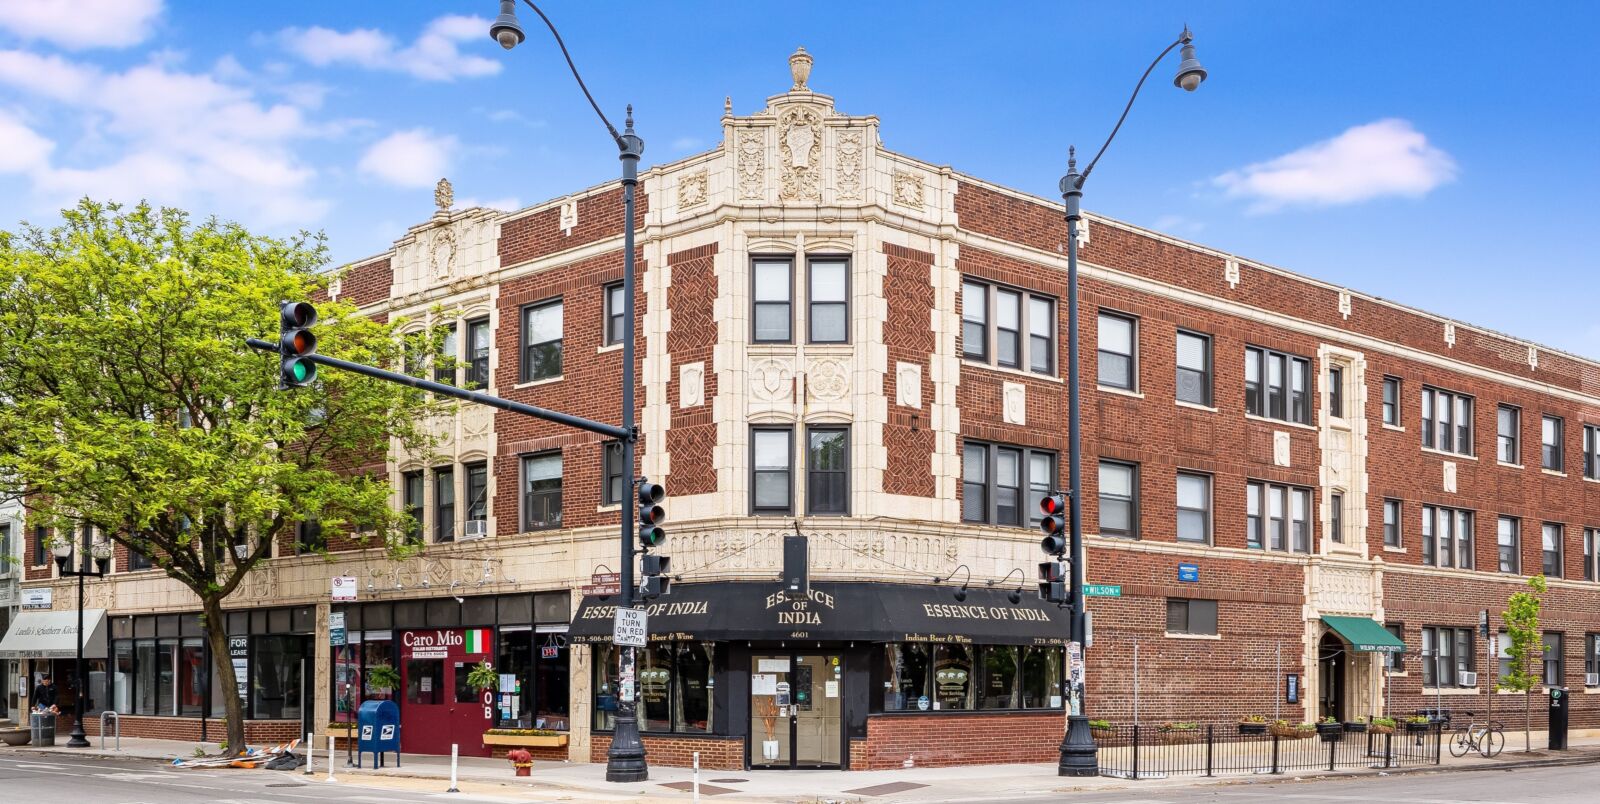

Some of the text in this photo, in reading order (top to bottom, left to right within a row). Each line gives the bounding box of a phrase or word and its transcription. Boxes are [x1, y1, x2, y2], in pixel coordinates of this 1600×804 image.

[1090, 586, 1115, 595] WILSON
[766, 589, 834, 609] ESNCE
[646, 603, 666, 617] OF
[667, 601, 709, 616] INDIA
[792, 602, 807, 610] OF
[626, 611, 637, 619] NO
[923, 604, 1050, 622] ESSENCE OF INDIA
[778, 612, 821, 624] INDIA
[622, 619, 640, 627] TURN
[617, 626, 627, 634] ON
[403, 630, 462, 646] Caro Mio
[651, 633, 666, 641] Beer
[676, 632, 694, 640] Wine
[905, 633, 928, 642] Indian
[930, 634, 946, 643] Beer
[955, 635, 972, 643] Wine
[230, 639, 247, 647] FOR
[544, 648, 557, 656] OPEN
